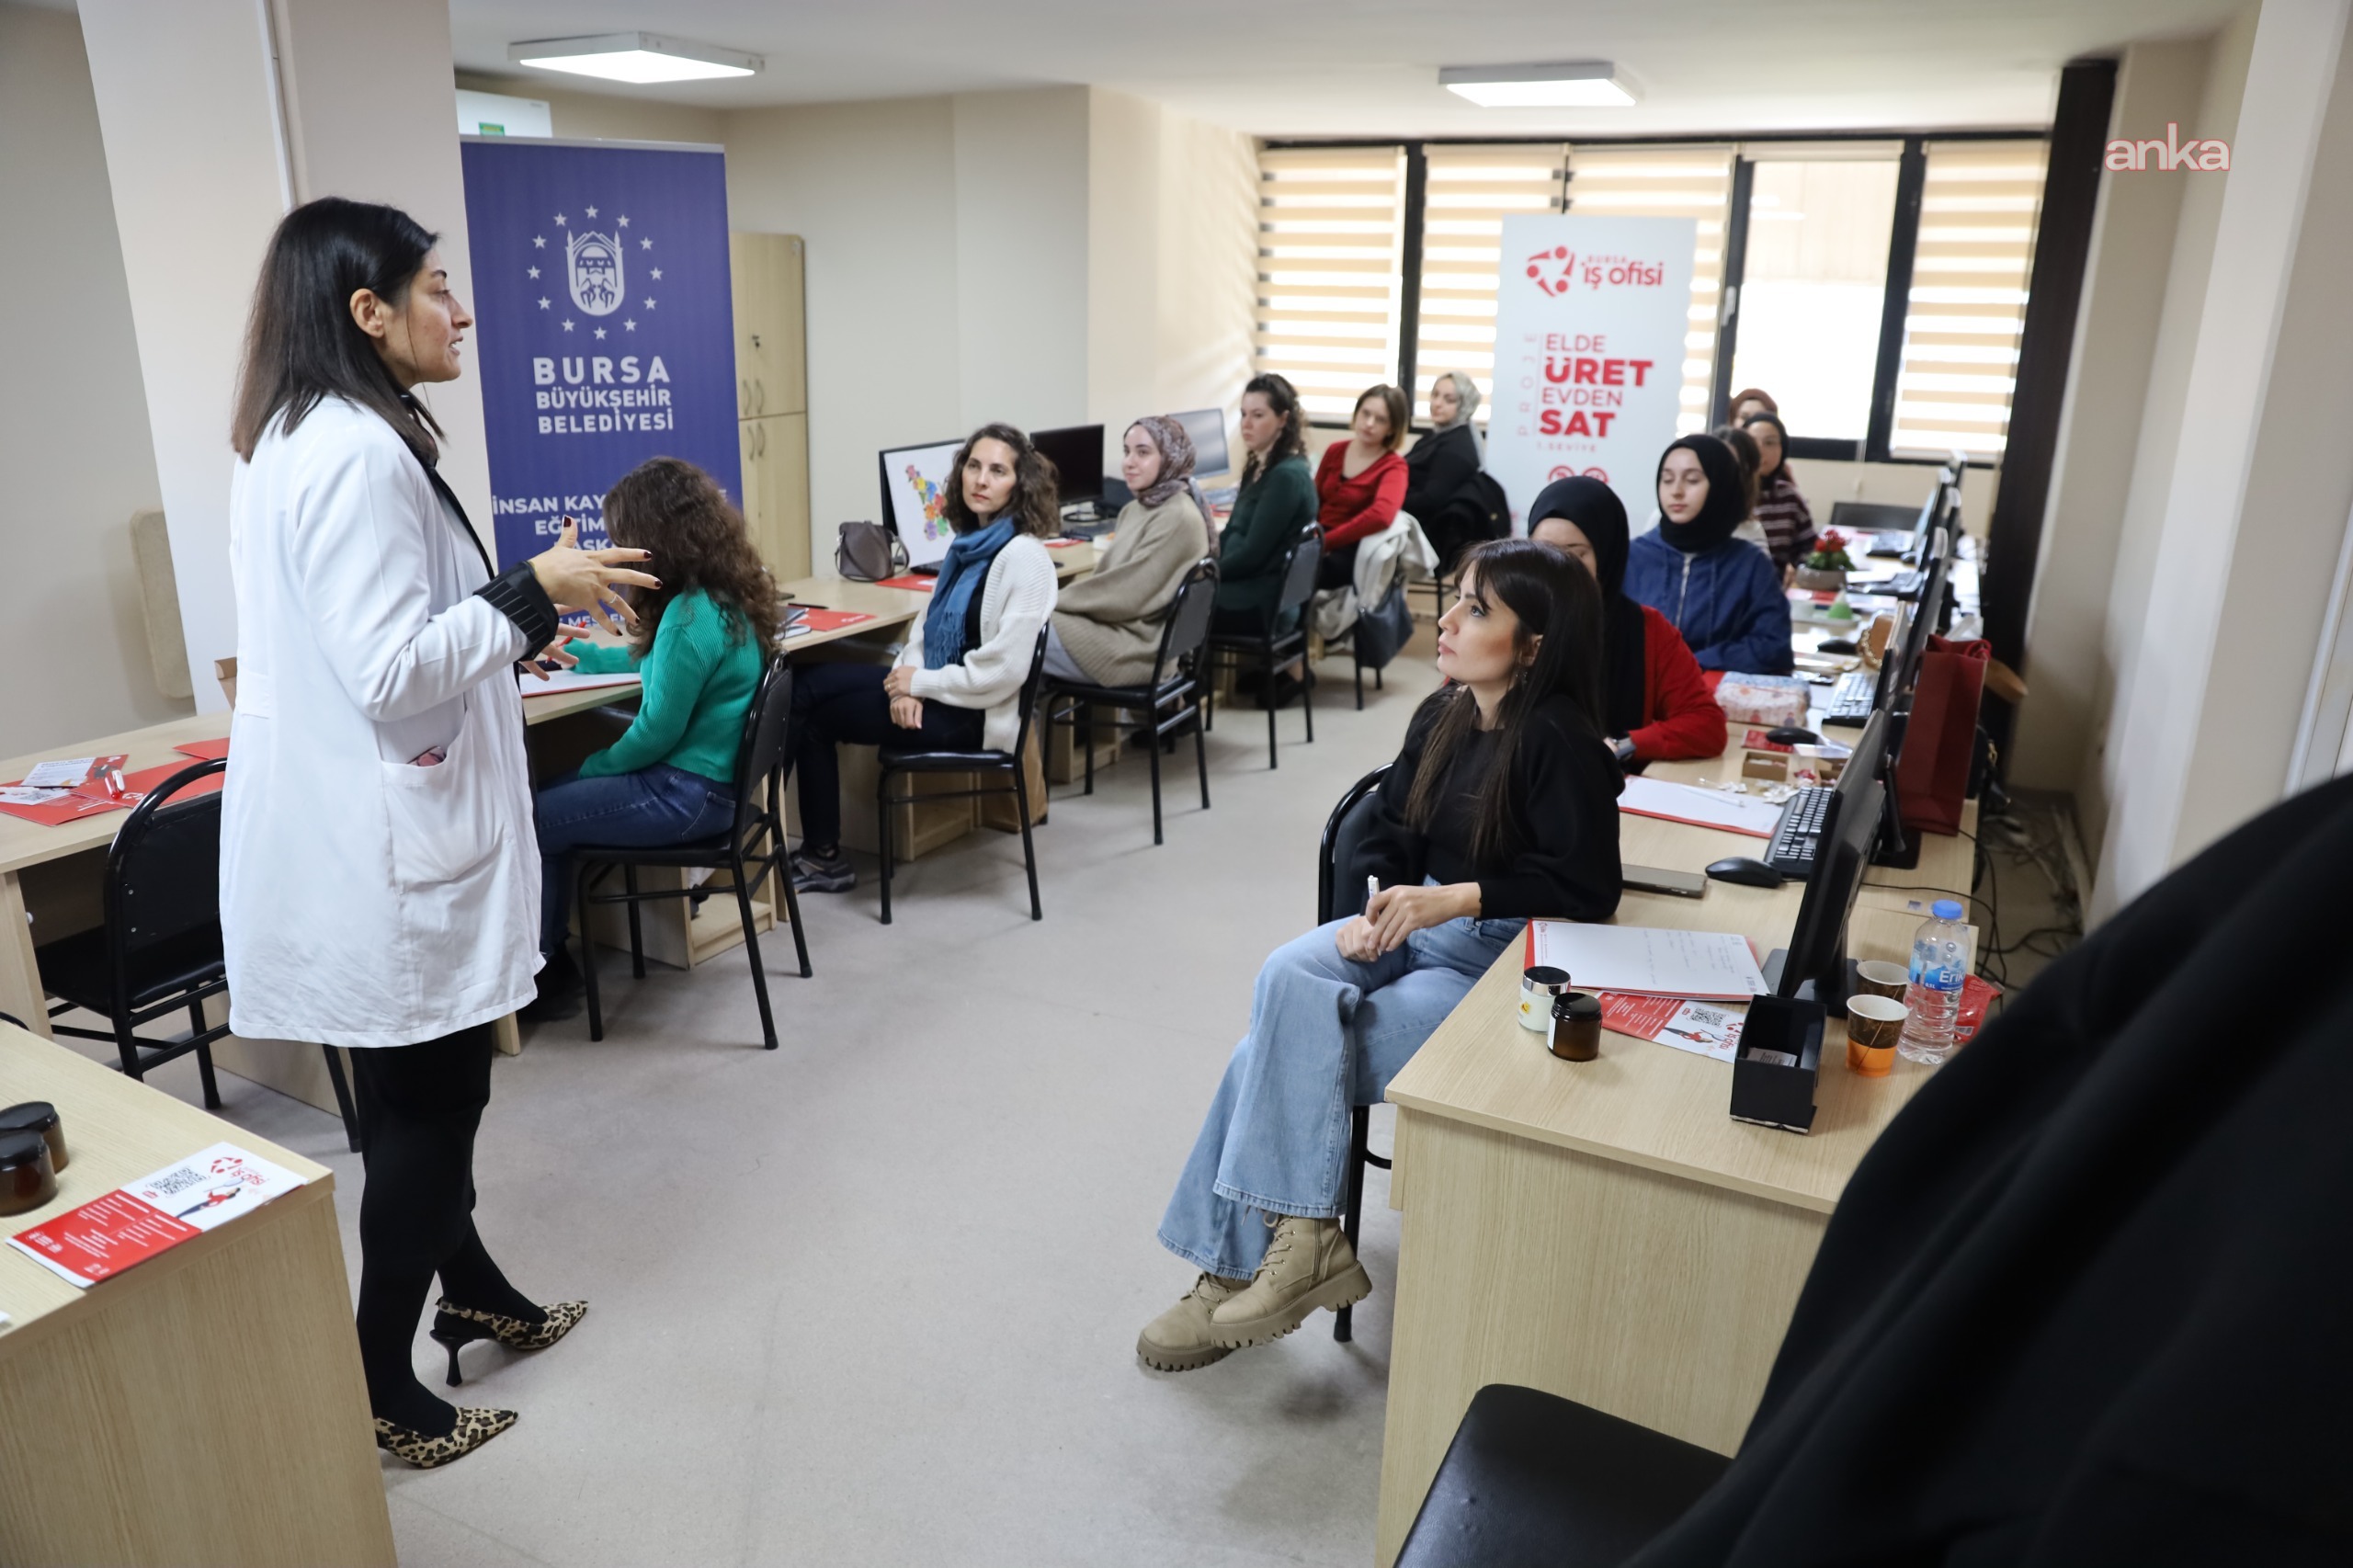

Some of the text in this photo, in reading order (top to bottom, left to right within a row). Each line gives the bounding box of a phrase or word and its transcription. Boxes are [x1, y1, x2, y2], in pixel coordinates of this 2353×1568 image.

[1581, 261, 1663, 290] iş ofisi
[1546, 334, 1606, 353] ELDE
[533, 356, 671, 385] BURSA
[1545, 356, 1654, 387] ÜRET
[536, 383, 672, 410] BÜYÜKŞEHİR
[1541, 387, 1623, 406] EVDEN
[538, 407, 674, 434] BELEDİYESİ
[1539, 409, 1616, 438] SAT
[491, 494, 607, 515] İNSAN KAY
[1939, 971, 1964, 983] Erik
